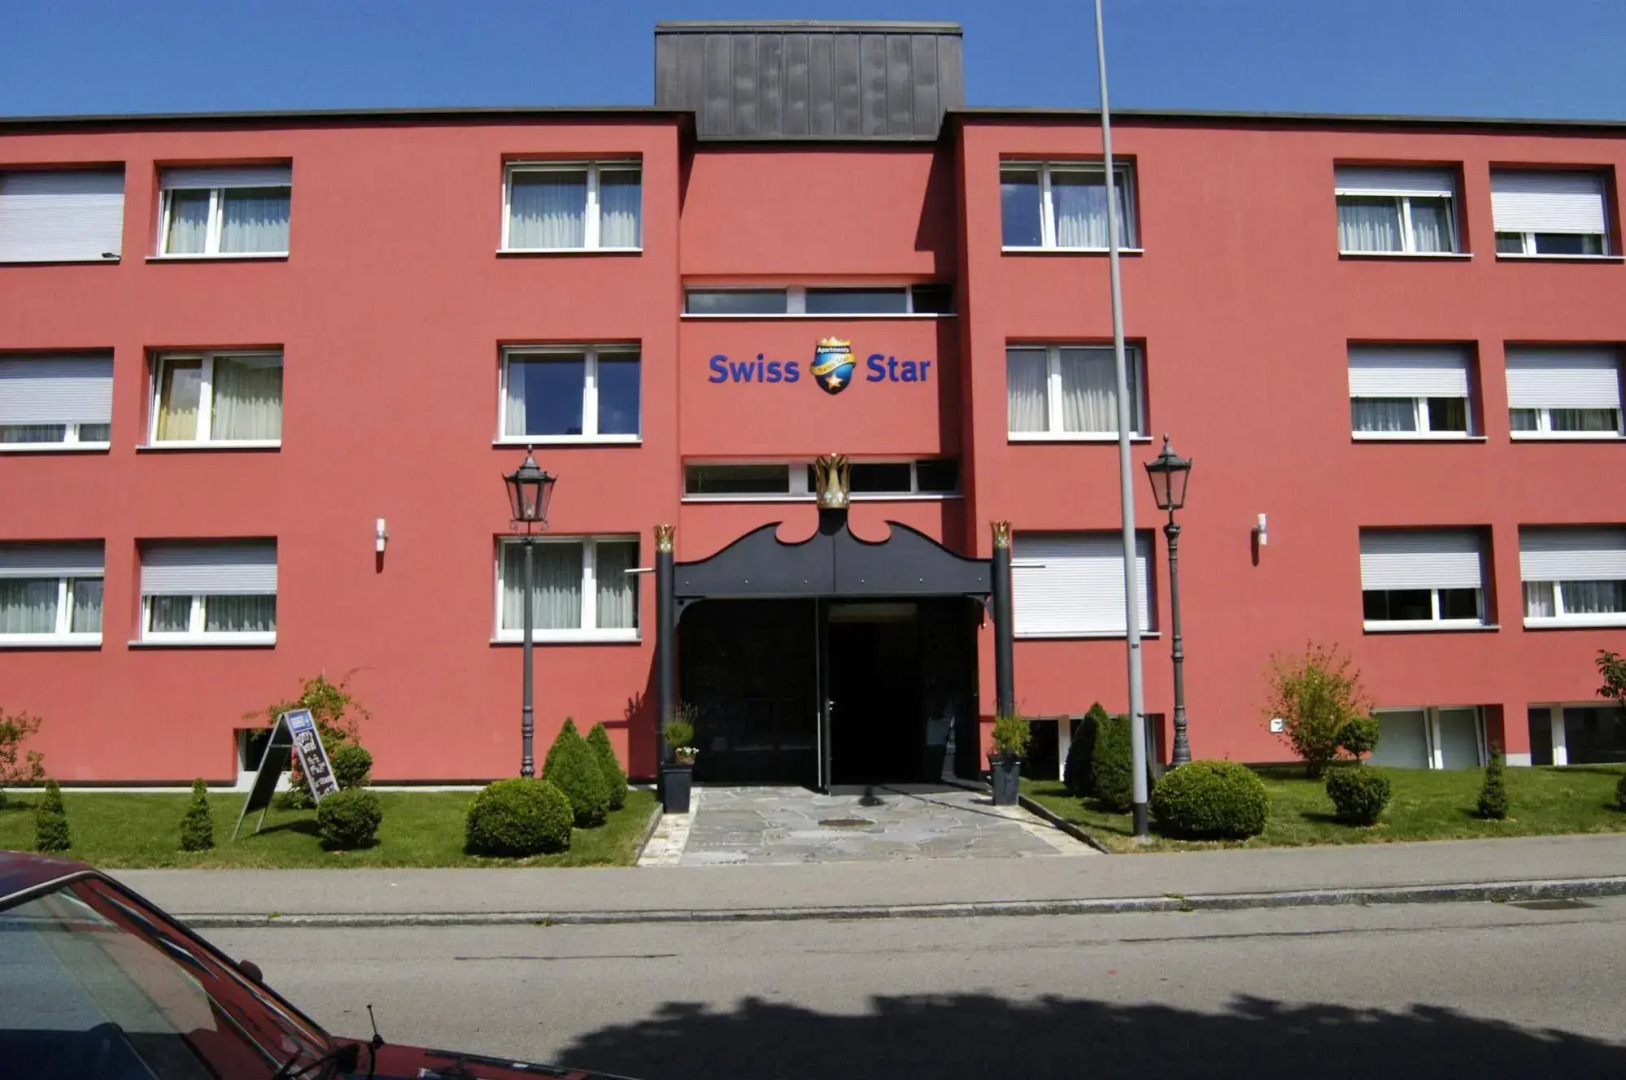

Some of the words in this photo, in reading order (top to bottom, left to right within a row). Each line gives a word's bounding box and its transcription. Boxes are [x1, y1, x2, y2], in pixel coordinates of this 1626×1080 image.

[816, 346, 850, 354] Apartments
[708, 353, 801, 383] Swiss
[866, 353, 931, 382] Star
